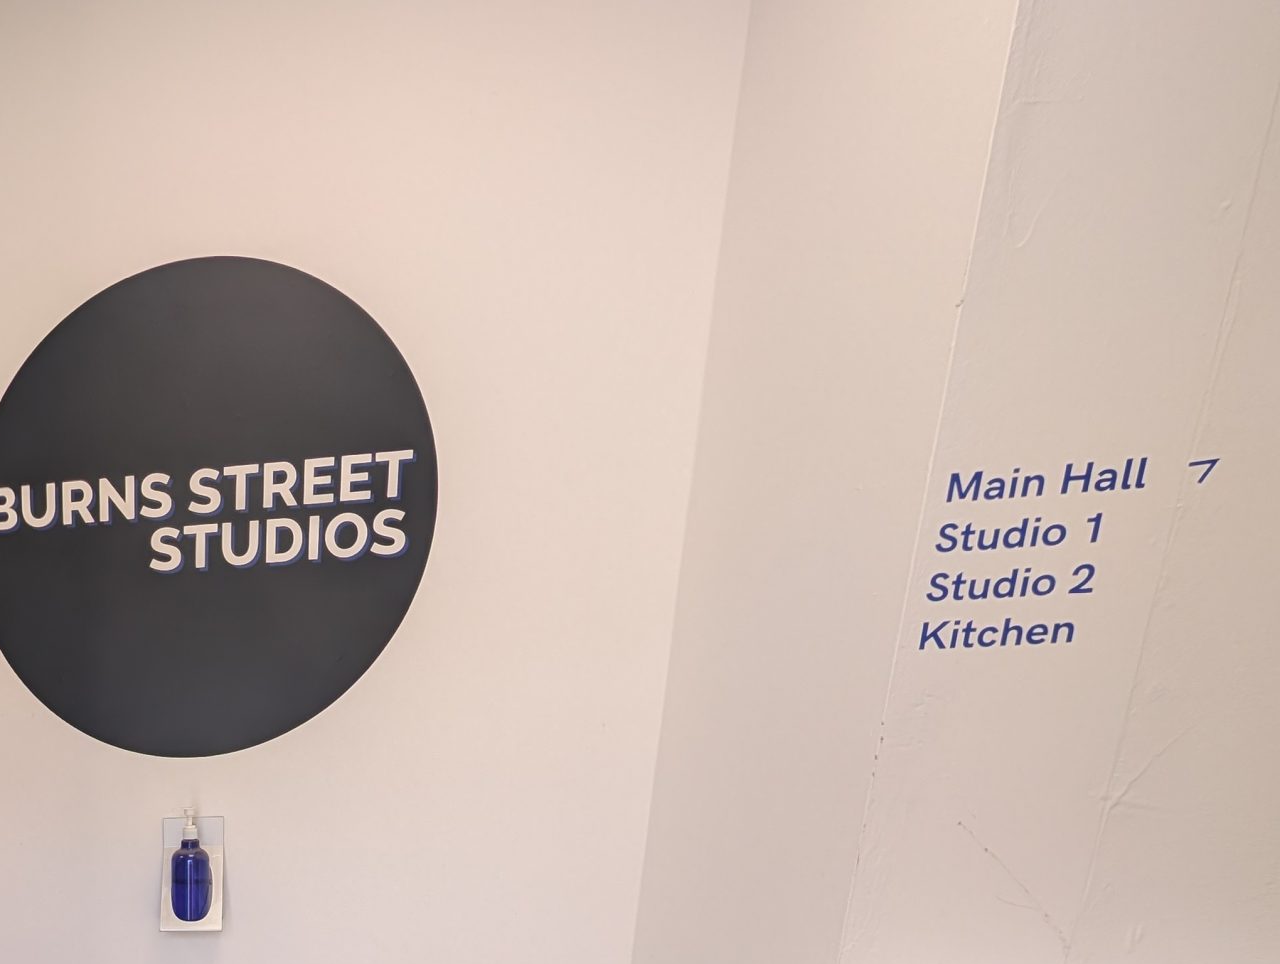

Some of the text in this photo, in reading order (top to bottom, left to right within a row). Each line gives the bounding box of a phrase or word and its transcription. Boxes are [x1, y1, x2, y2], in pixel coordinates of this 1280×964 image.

[187, 449, 417, 515] STREET
[946, 456, 1148, 503] Main Hall
[149, 508, 409, 573] STUDIOS
[934, 512, 1103, 553] Studio 1
[925, 563, 1096, 602] Studio 2
[918, 617, 1075, 650] Kitchen
